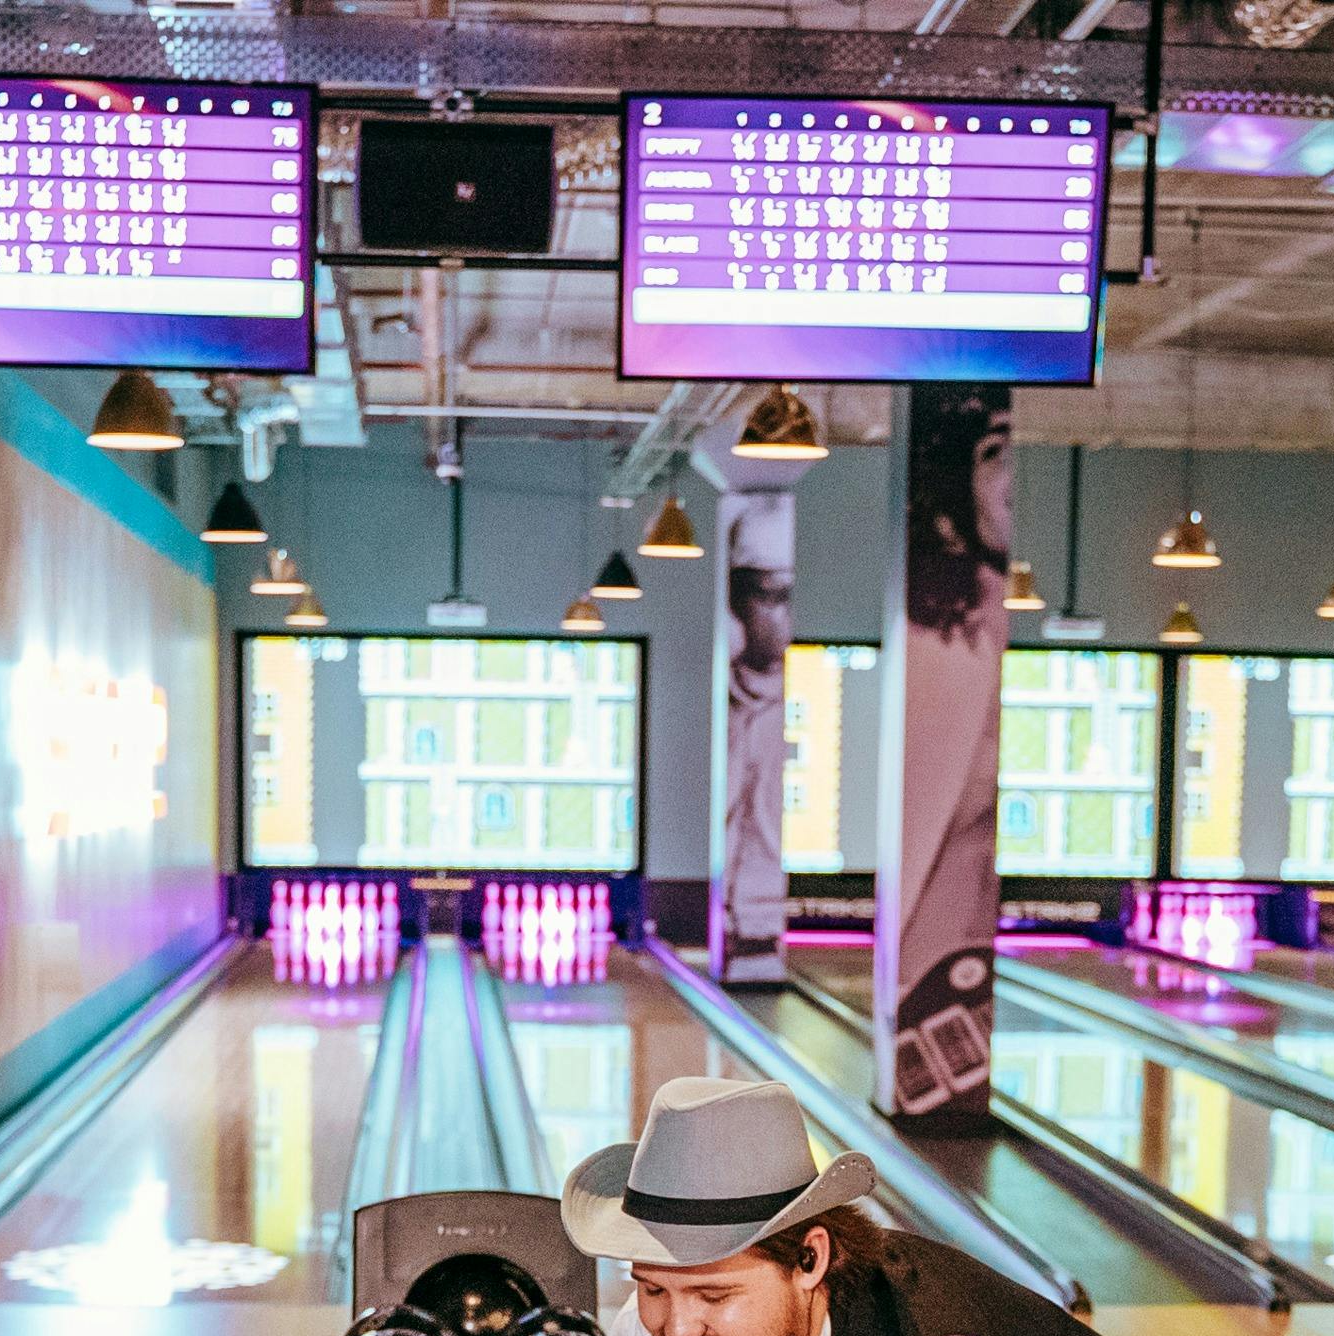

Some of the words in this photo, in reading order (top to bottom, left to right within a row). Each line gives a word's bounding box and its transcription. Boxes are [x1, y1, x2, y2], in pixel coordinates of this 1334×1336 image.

[133, 96, 145, 111] 7
[643, 101, 662, 126] 2
[935, 116, 948, 131] 7
